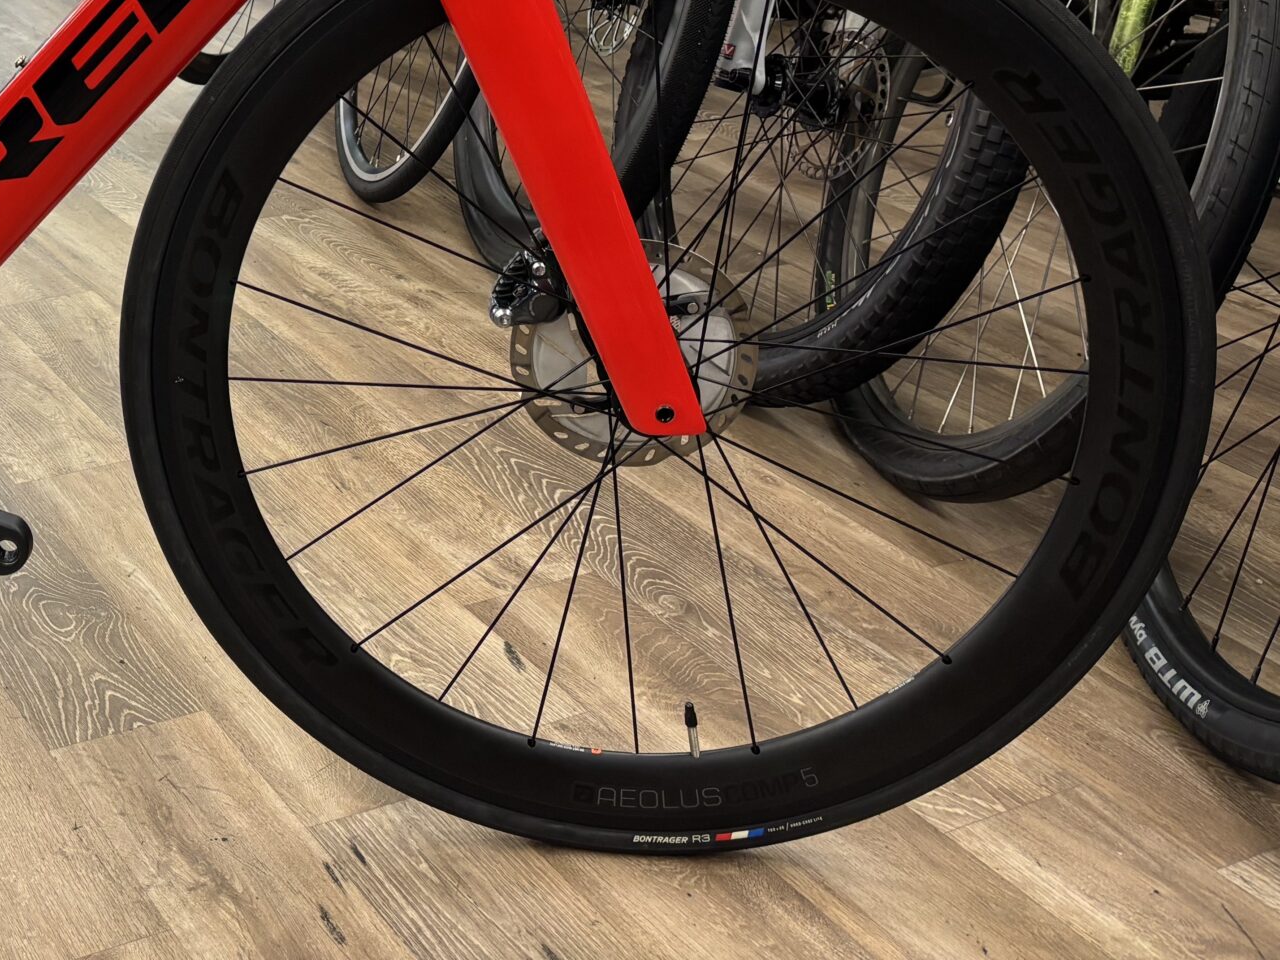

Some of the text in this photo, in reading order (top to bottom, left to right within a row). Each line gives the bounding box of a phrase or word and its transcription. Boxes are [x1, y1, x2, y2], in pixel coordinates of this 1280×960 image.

[177, 166, 340, 668] BONTRAGER
[994, 68, 1156, 603] BONTRAGER
[1144, 646, 1202, 710] WTB
[632, 833, 711, 844] BONTRAGER R3
